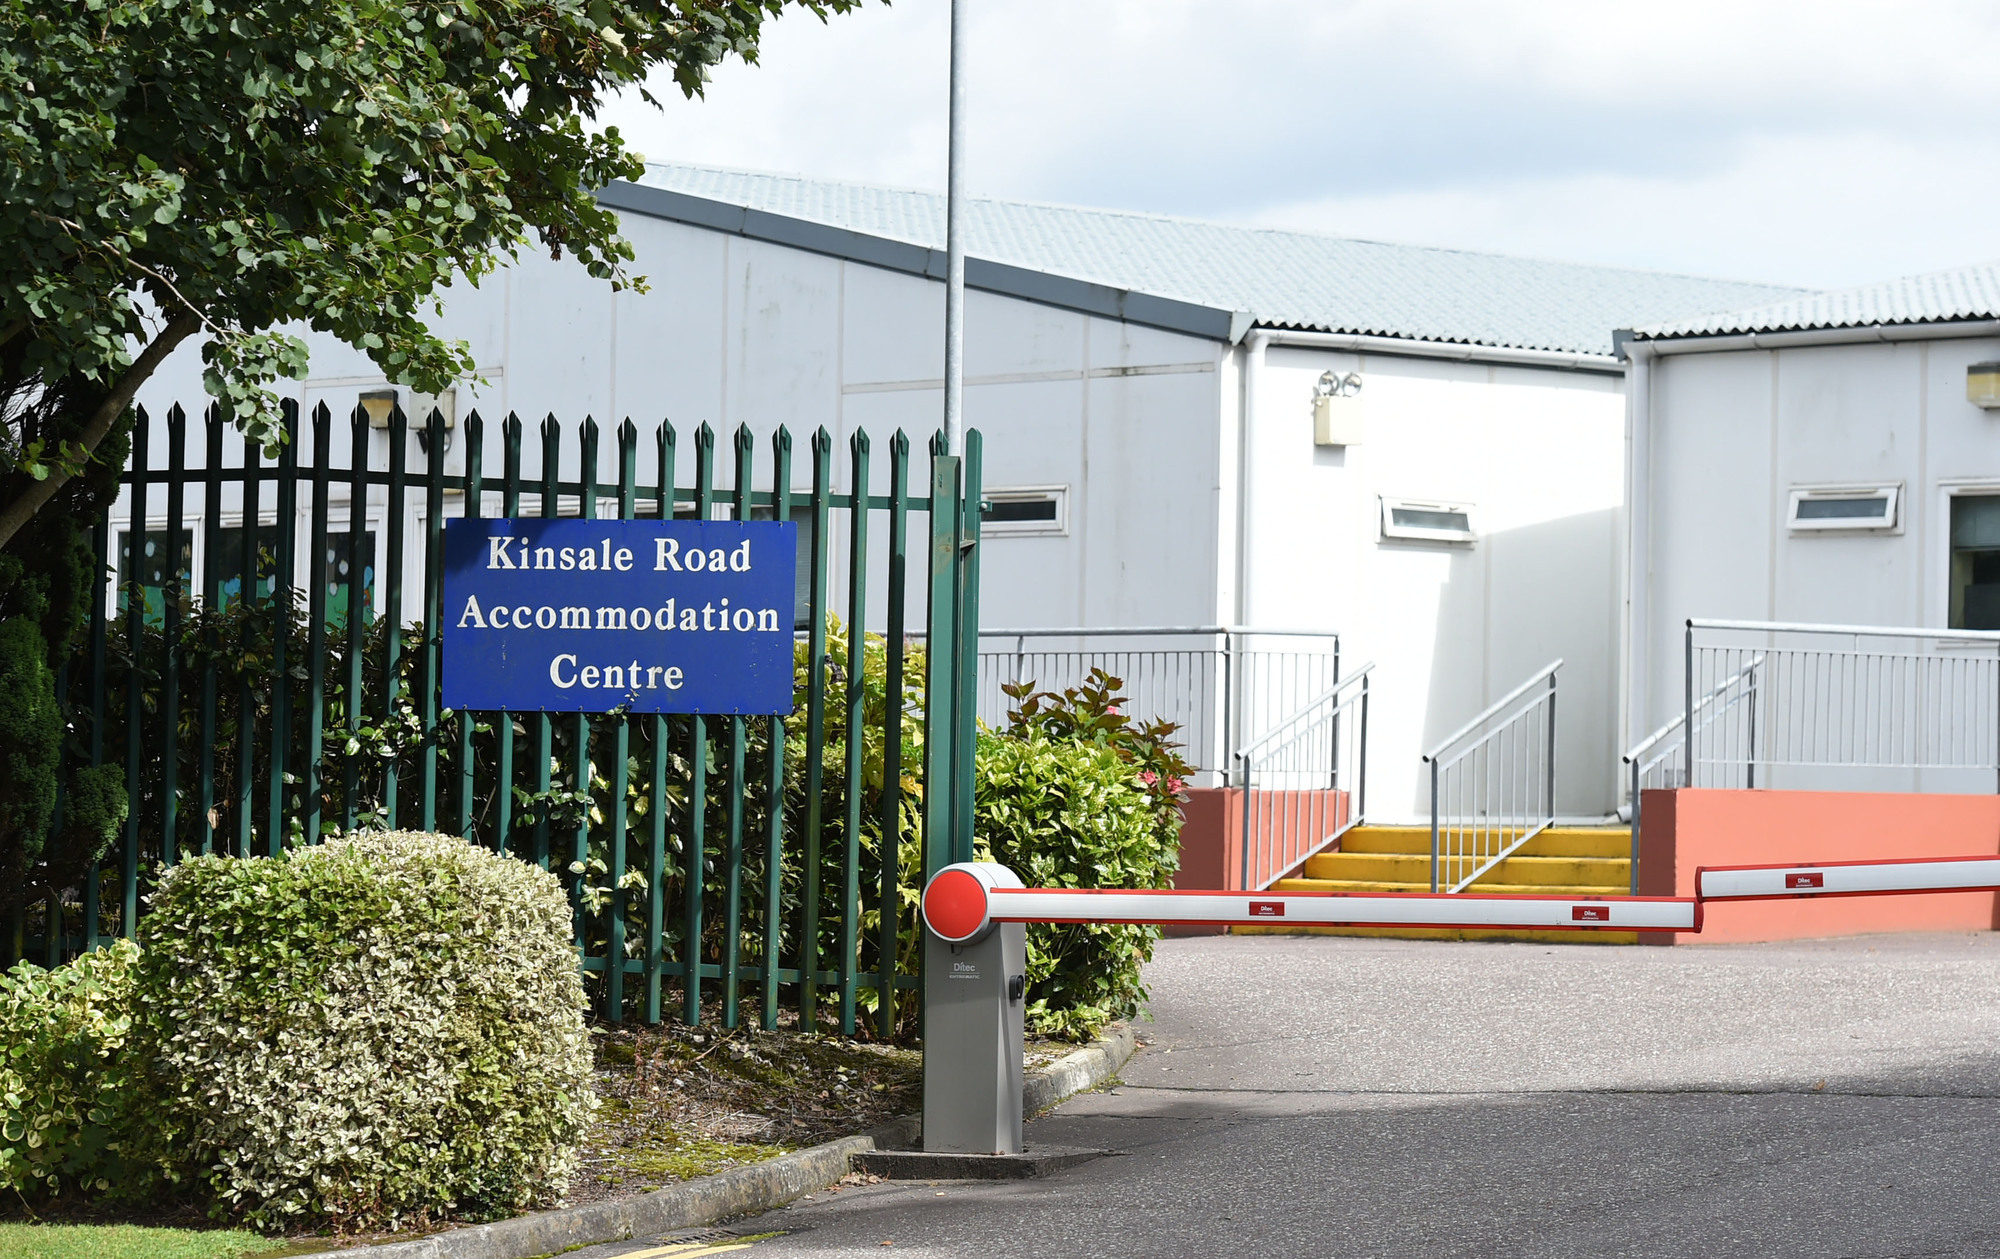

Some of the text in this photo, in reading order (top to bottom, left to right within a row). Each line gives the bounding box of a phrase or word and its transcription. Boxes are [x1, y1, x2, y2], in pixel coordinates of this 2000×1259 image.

[487, 536, 752, 572] Kinsale Road
[457, 594, 780, 632] Accommodation
[549, 653, 684, 690] Centre
[953, 961, 976, 971] Ditec
